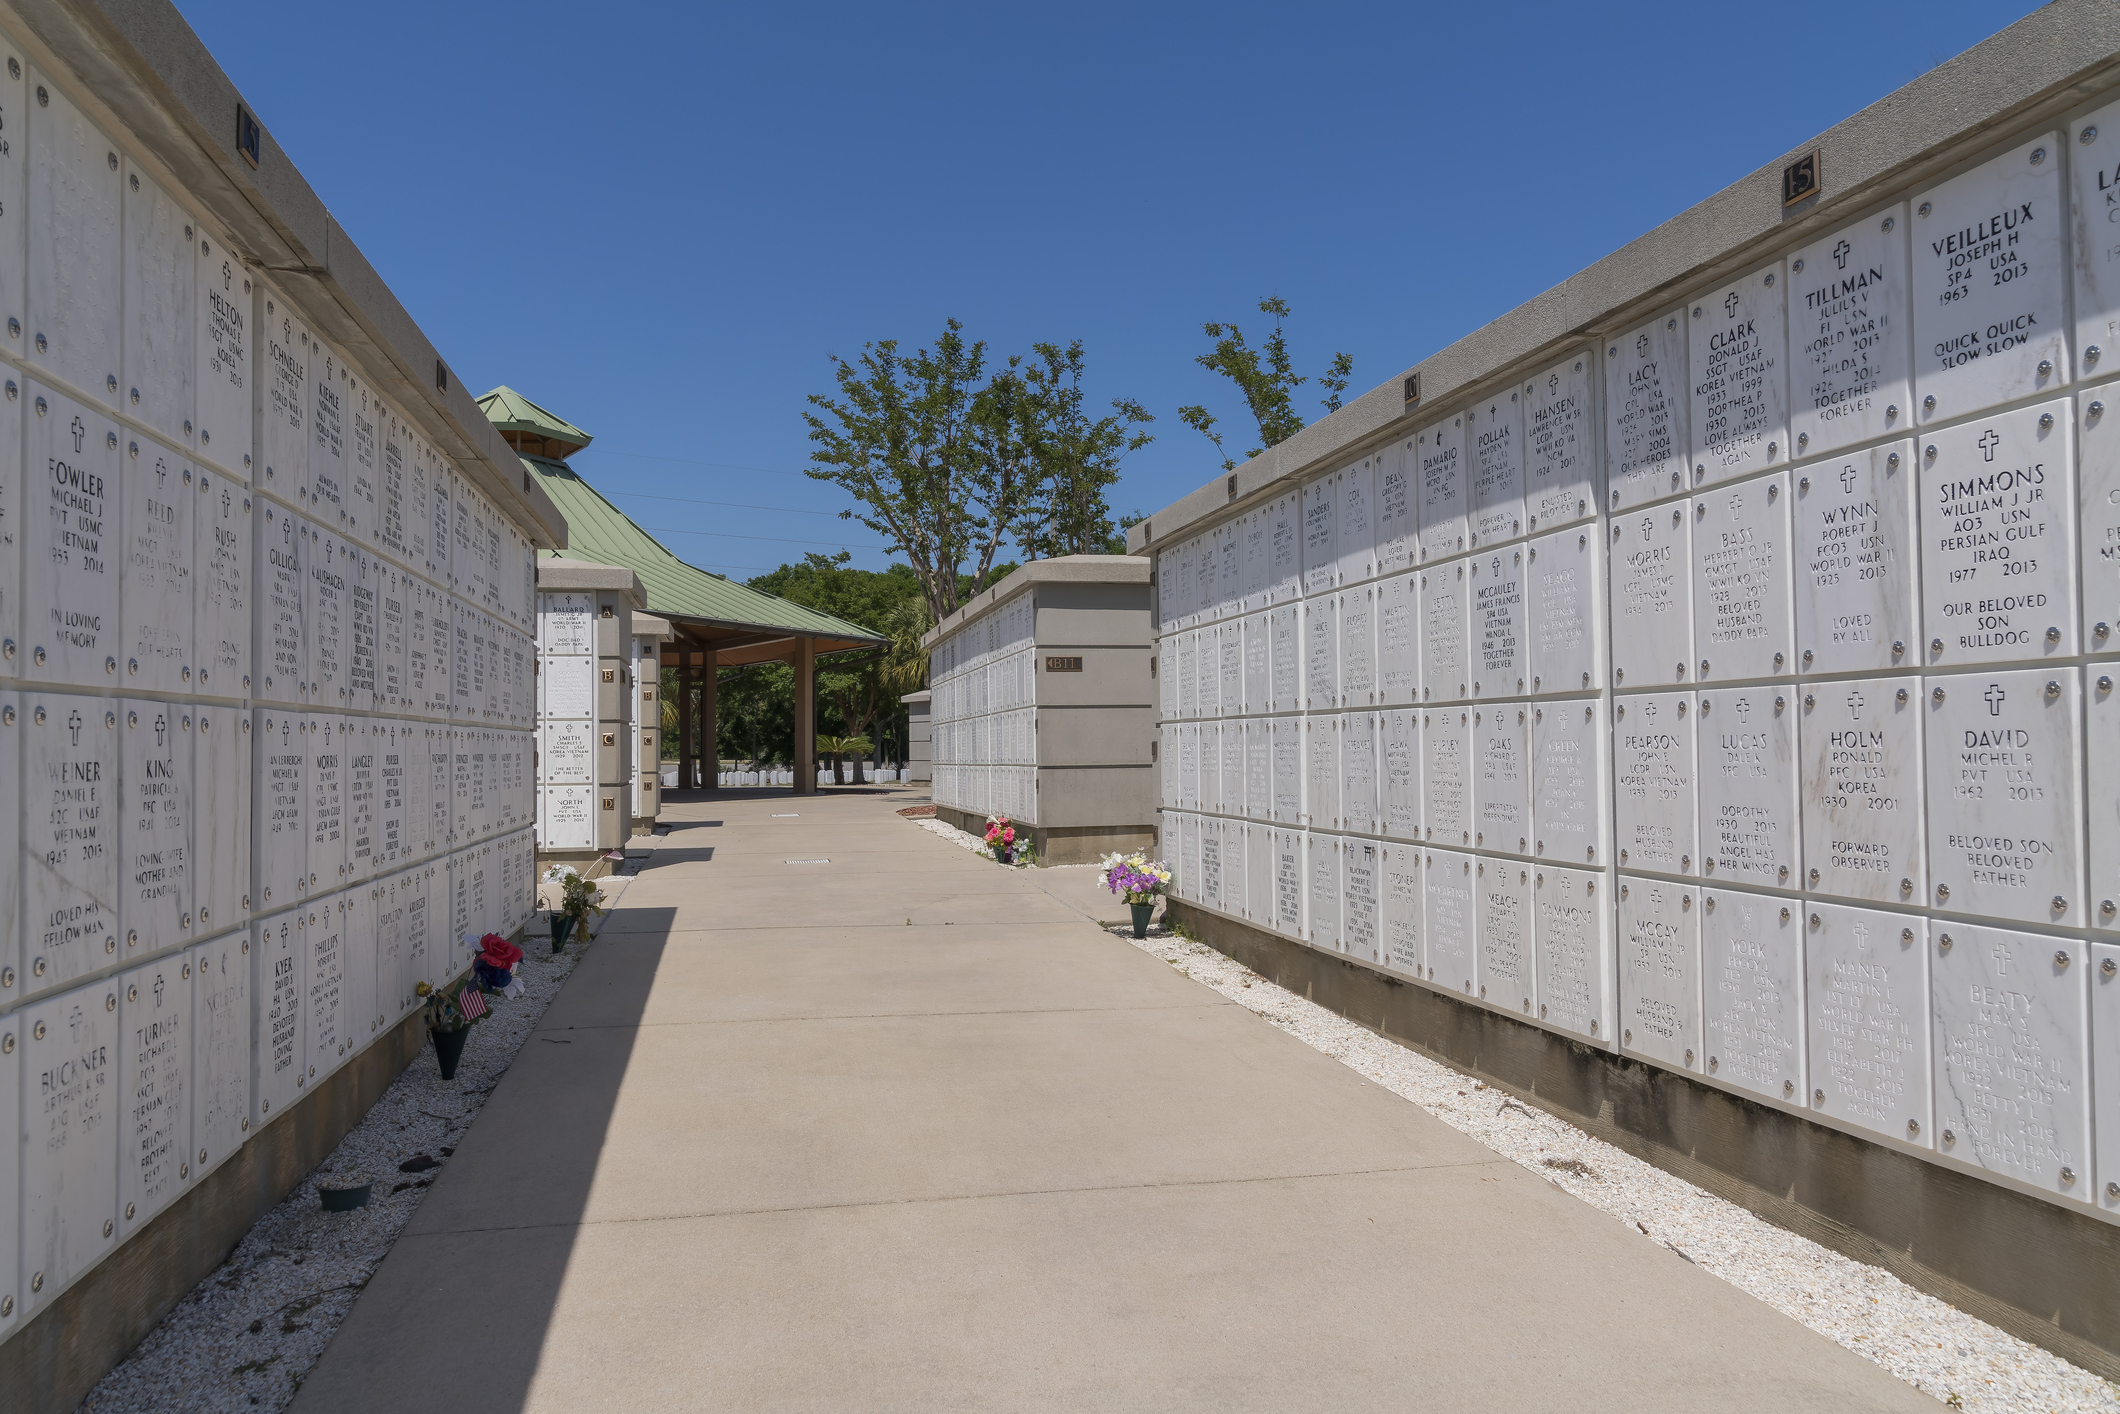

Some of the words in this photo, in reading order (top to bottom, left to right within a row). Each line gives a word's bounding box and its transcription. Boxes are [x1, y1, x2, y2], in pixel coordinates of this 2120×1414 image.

[1786, 157, 1812, 198] 15
[1932, 202, 2034, 258] VEILLEUX
[1946, 242, 2000, 270] JOSEPH
[2008, 231, 2018, 246] H
[1948, 267, 1972, 286] SP4
[1990, 251, 2017, 270] USA
[1806, 264, 1882, 310] TILLMAN
[1940, 286, 1968, 306] 1963
[1994, 262, 2028, 286] 2013
[210, 289, 243, 331] HELTON
[1819, 295, 1856, 320] JULIUS
[212, 312, 237, 340] THOMAS
[1710, 319, 1756, 350] CLARK
[1804, 331, 1844, 354] WORLD
[1850, 320, 1875, 336] WAR
[1935, 332, 1980, 357] QUICK
[1987, 313, 2037, 341] QUICK
[229, 340, 244, 362] USMC
[1709, 340, 1748, 365] DONALD
[1753, 336, 1759, 348] J
[1853, 334, 1879, 352] 2013
[1942, 348, 1981, 372] SLOW
[1987, 332, 2029, 356] SLOW
[217, 347, 236, 370] KOREA
[270, 340, 303, 381] SCHNELLE
[1706, 362, 1728, 380] SSGT
[1739, 349, 1762, 366] USAF
[1629, 362, 1658, 386] LACY
[1696, 378, 1725, 396] KOREA
[1729, 358, 1774, 382] VIETNAM
[318, 382, 339, 411] KIEHLE
[1707, 390, 1726, 405] 1933
[1742, 377, 1762, 392] 1999
[1814, 380, 1878, 409] TOGETHER
[1535, 396, 1574, 424] HANSEN
[1708, 395, 1753, 418] DORTHEA
[1757, 391, 1762, 400] P
[1820, 398, 1872, 422] FOREVER
[355, 413, 373, 436] STUART
[1706, 416, 1727, 432] 1930
[1743, 404, 1766, 420] 2013
[1479, 425, 1510, 448] POLLAK
[1705, 429, 1728, 446] LOVE
[1732, 416, 1768, 437] ALWAYS
[1710, 432, 1762, 457] TOGETHER
[1424, 447, 1457, 470] DAMARIO
[1721, 450, 1751, 468] AGAIN
[49, 458, 104, 500] FOWLER
[1940, 464, 2045, 503] SIMMONS
[52, 486, 93, 515] MICHAEL
[1941, 497, 2003, 519] WILLIAM
[2011, 493, 2018, 507] J
[2026, 488, 2044, 504] JR
[1822, 500, 1878, 527] WYNN
[1954, 517, 1982, 533] AO3
[2001, 508, 2030, 525] USN
[79, 516, 103, 538] USMC
[216, 527, 236, 549] RUSH
[1722, 528, 1753, 548] BASS
[1822, 523, 1865, 542] ROBERT
[1872, 521, 1878, 533] J
[1941, 530, 1999, 552] PERSIAN
[2006, 524, 2046, 541] GULF
[1817, 543, 1847, 557] FCO3
[1861, 536, 1884, 550] USN
[1974, 547, 2010, 564] IRAQ
[84, 556, 104, 574] 2014
[1626, 547, 1671, 570] MORRIS
[1810, 557, 1851, 574] WORLD
[1857, 552, 1882, 564] WAR
[1817, 574, 1840, 587] 1925
[1859, 566, 1886, 581] 2013
[1950, 568, 1976, 584] 1977
[2003, 560, 2037, 576] 2013
[1478, 582, 1516, 599] MCCAULEY
[1476, 599, 1493, 610] JAMES
[1496, 594, 1520, 606] FRANCIS
[1498, 607, 1508, 616] USA
[1718, 600, 1761, 615] BELOVED
[1943, 602, 1972, 617] OUR
[1979, 594, 2046, 614] BELOVED
[52, 608, 62, 622] IN
[66, 612, 100, 632] LOVING
[1485, 618, 1512, 629] VIETNAM
[1717, 614, 1763, 629] HUSBAND
[1833, 615, 1872, 630] LOVED
[1978, 615, 2009, 630] SON
[56, 630, 96, 649] MEMORY
[1482, 641, 1494, 650] 1946
[1502, 638, 1516, 648] 2013
[1485, 629, 1505, 638] WANDA
[1833, 630, 1845, 644] BY
[1852, 630, 1872, 642] ALL
[1960, 631, 2030, 648] BULLDOG
[1054, 658, 1075, 668] B11
[1483, 648, 1515, 660] TOGETHER
[1486, 660, 1512, 670] FOREVER
[604, 672, 612, 680] B
[604, 735, 613, 744] C
[1489, 738, 1511, 750] OAKS
[1625, 735, 1679, 750] PEARSON
[1722, 734, 1767, 750] LUCAS
[1831, 732, 1883, 750] HOLM
[1964, 730, 2029, 749] DAVID
[146, 759, 174, 779] KING
[1833, 752, 1883, 765] RONALD
[1961, 753, 2017, 766] MICHEL
[2024, 754, 2033, 766] R
[1830, 767, 1850, 780] PFC
[1864, 767, 1886, 780] USA
[1962, 770, 1988, 783] PVT
[2006, 770, 2033, 784] USA
[1839, 782, 1877, 794] KOREA
[1954, 786, 1983, 799] 1962
[2008, 787, 2043, 801] 2013
[605, 800, 612, 808] D
[1722, 806, 1770, 819] DOROTHY
[1821, 796, 1847, 809] 1930
[1868, 798, 1898, 812] 2001
[1722, 833, 1771, 847] BEAUTIFUL
[1832, 841, 1889, 857] FORWARD
[1949, 835, 2012, 852] BELOVED
[2020, 840, 2053, 855] SON
[1831, 856, 1890, 873] OBSERVER
[1967, 853, 2033, 870] BELOVED
[1973, 870, 2028, 888] FATHER
[51, 905, 81, 927] LOVED
[85, 902, 99, 915] HIS
[44, 928, 80, 947] FELLOW
[84, 920, 104, 935] MAN
[1637, 920, 1678, 942] MCCAY
[275, 957, 293, 977] KYER
[1834, 957, 1890, 983] MANEY
[1970, 984, 2035, 1015] BEATY
[137, 1014, 179, 1046] TURNER
[273, 1014, 294, 1033] DEVOTED
[272, 1027, 294, 1047] HUSBAND
[274, 1041, 293, 1060] LOVING
[41, 1046, 107, 1096] BUCKNER
[274, 1055, 292, 1074] FATHER
